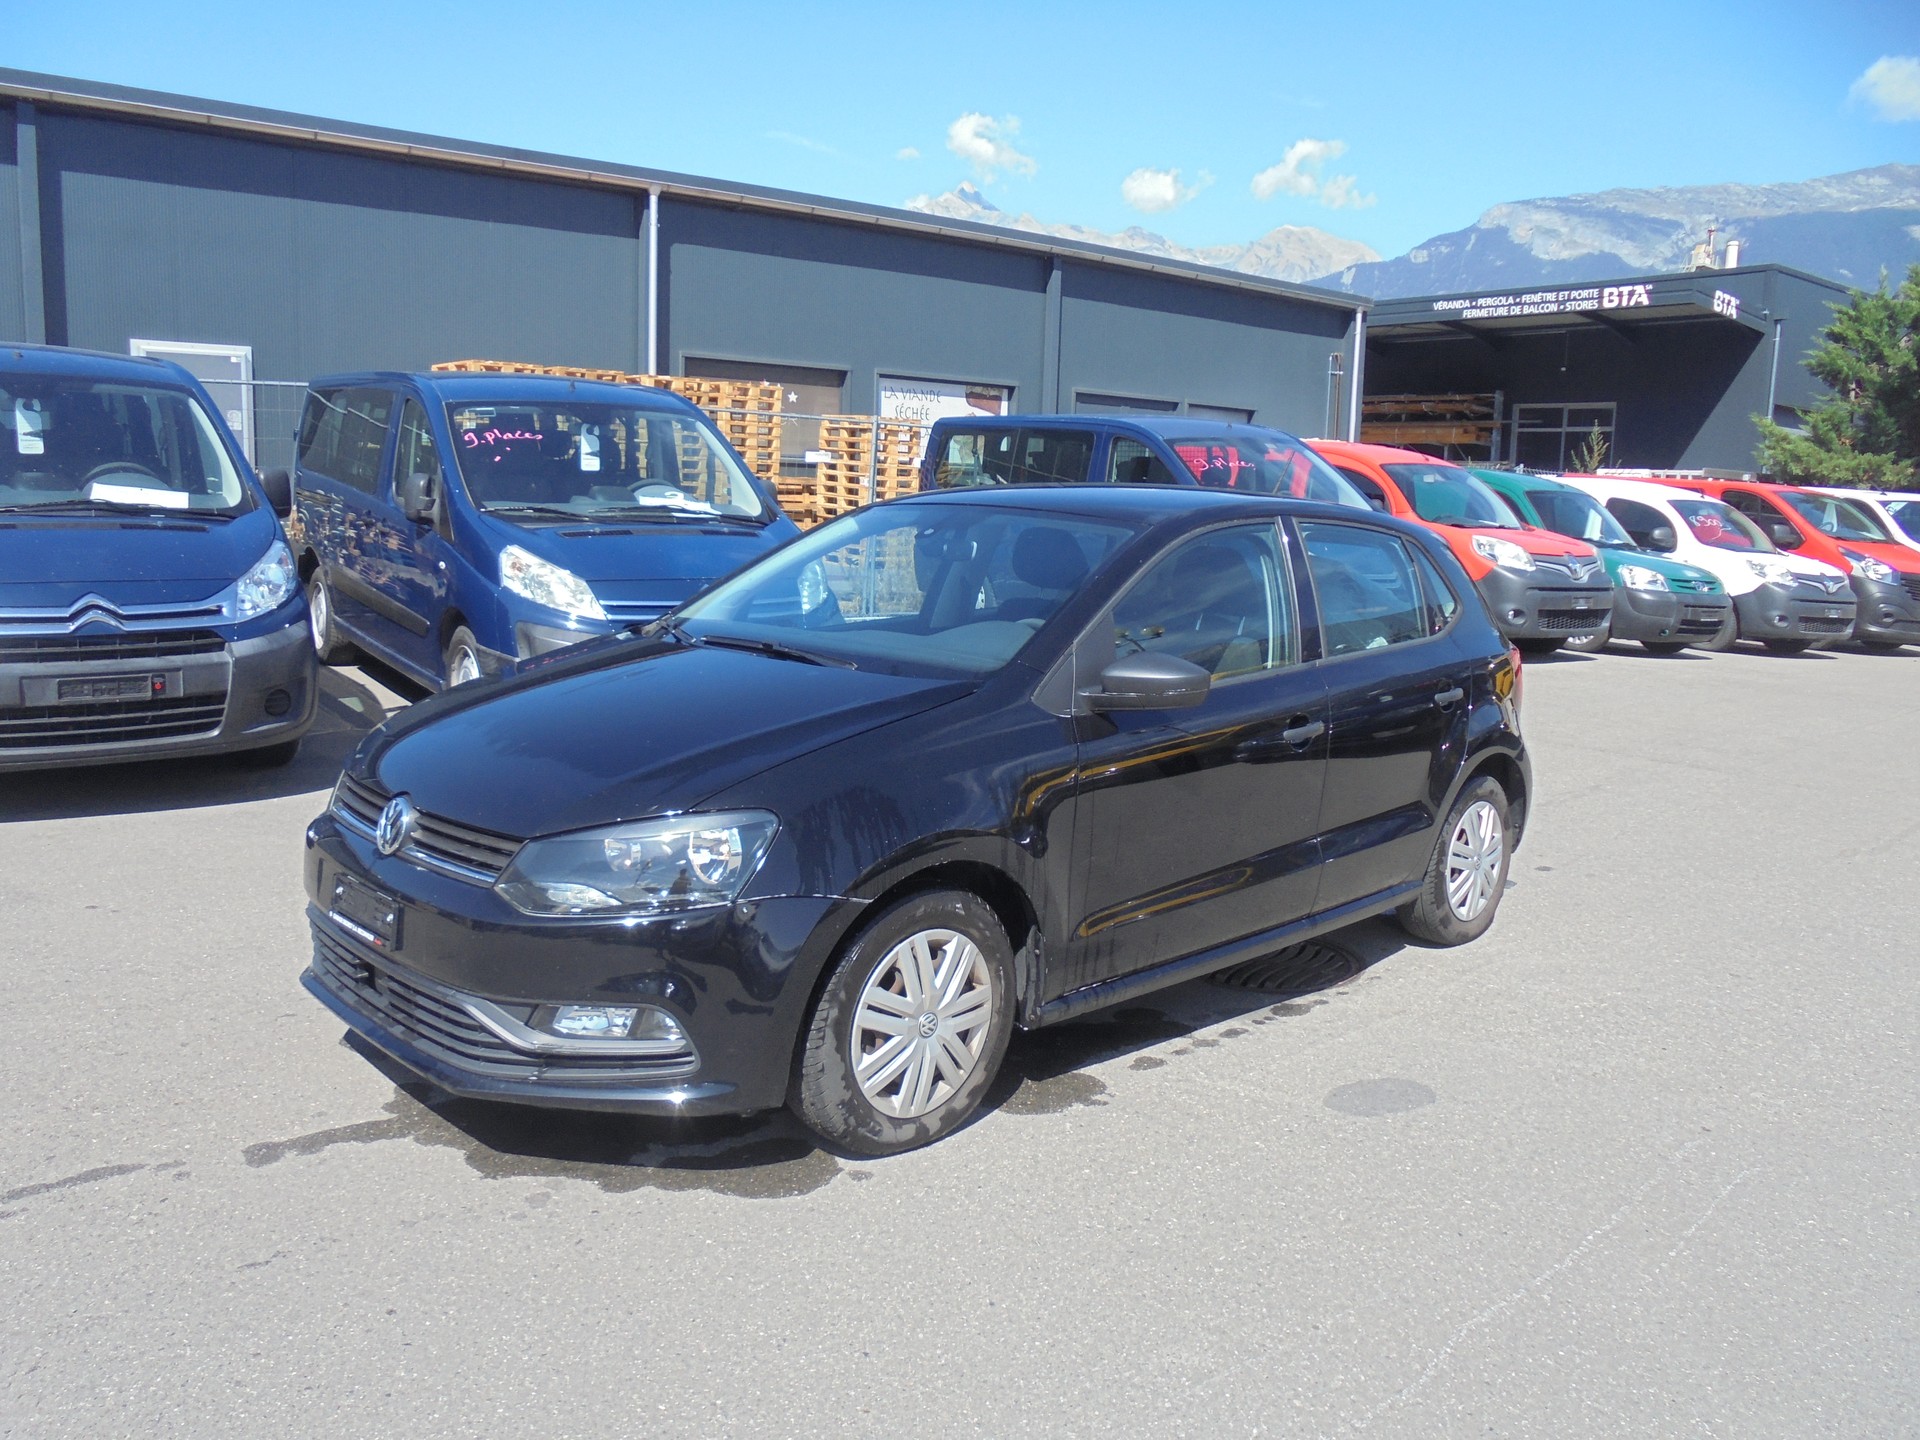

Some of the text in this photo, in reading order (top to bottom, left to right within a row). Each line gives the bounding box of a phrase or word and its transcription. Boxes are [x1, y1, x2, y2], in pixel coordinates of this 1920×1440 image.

[1433, 288, 1600, 311] VÉRANDA PERGOLA FENÊTRE ET PORTE
[1602, 284, 1650, 308] BTA
[1713, 289, 1737, 319] BTA
[1462, 299, 1599, 318] FERMETURE DE BALCON STORES
[884, 385, 941, 403] LA VIANDE
[895, 402, 930, 421] SÉCHÉE
